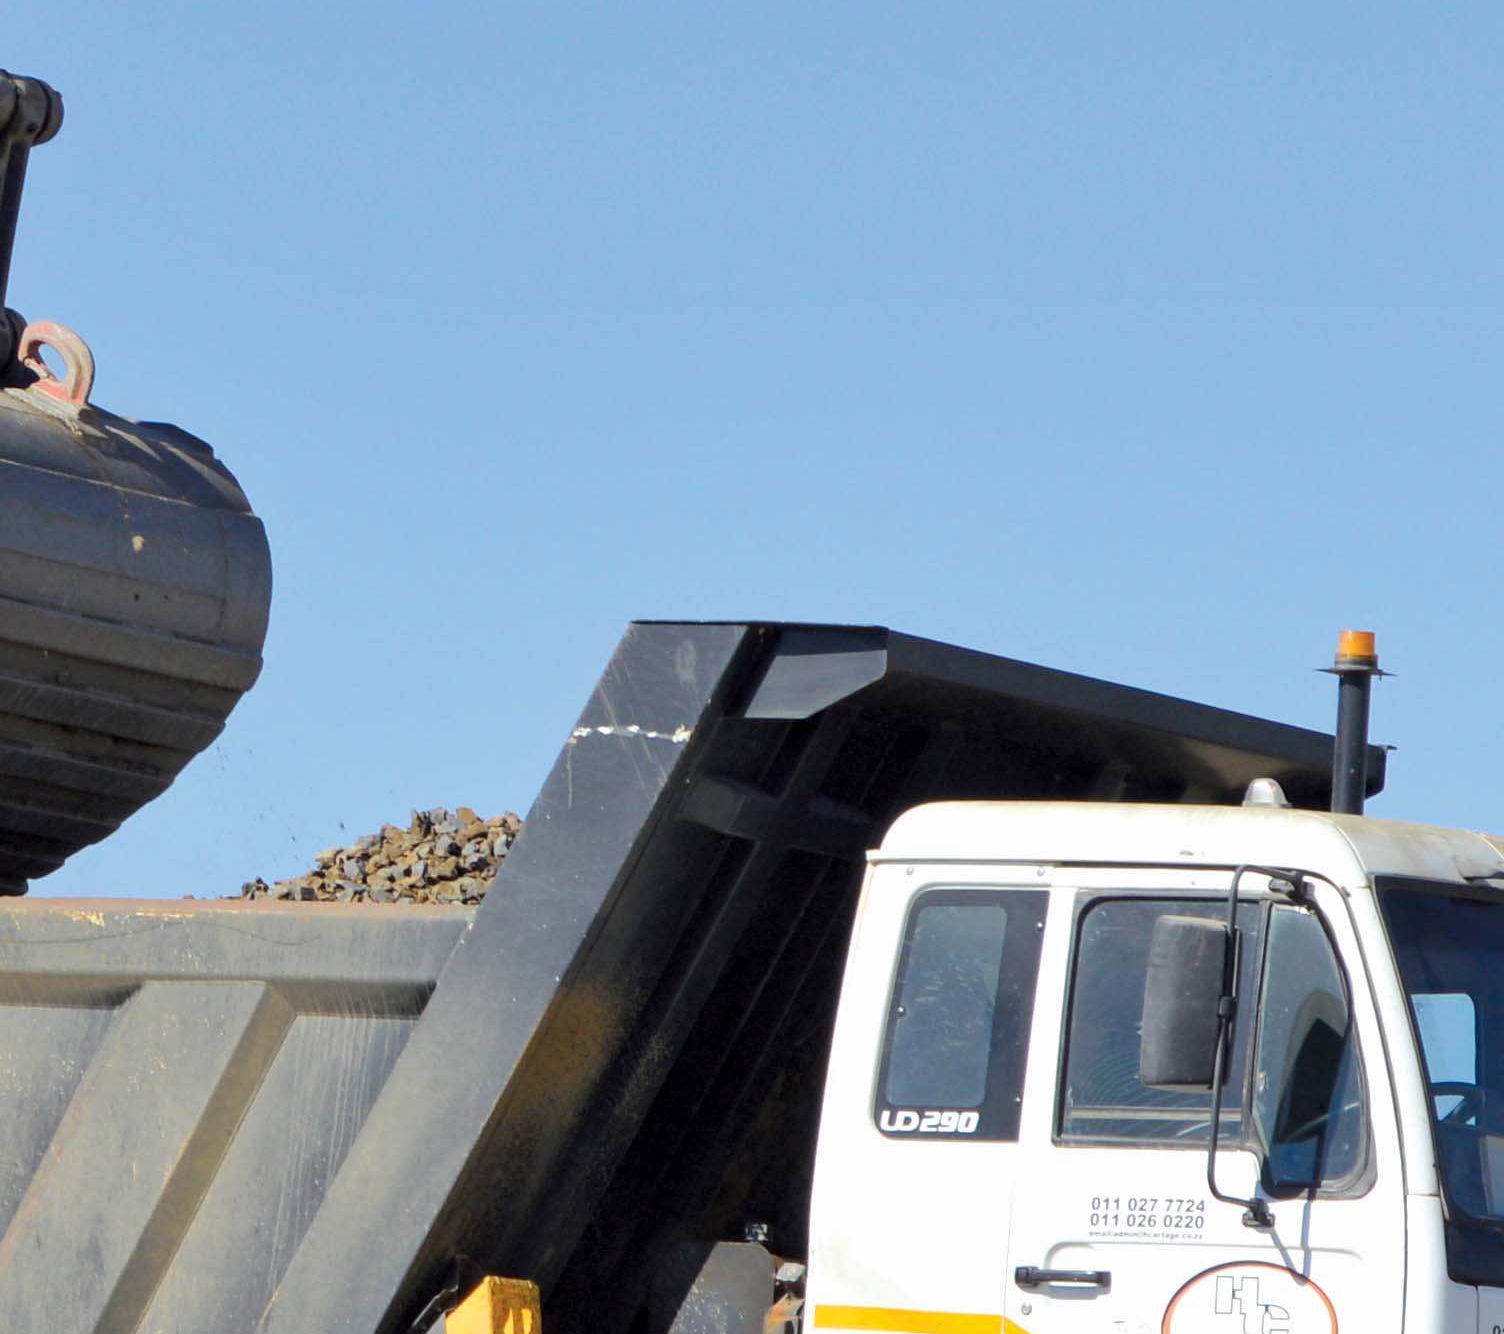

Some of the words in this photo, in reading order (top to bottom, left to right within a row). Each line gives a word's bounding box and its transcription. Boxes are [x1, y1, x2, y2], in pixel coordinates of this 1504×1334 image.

[1091, 1196, 1120, 1211] 011
[1127, 1197, 1158, 1212] 027
[1164, 1198, 1205, 1213] 7724
[1090, 1212, 1119, 1227] 011
[1126, 1213, 1157, 1228] 026
[1163, 1214, 1205, 1229] 0220
